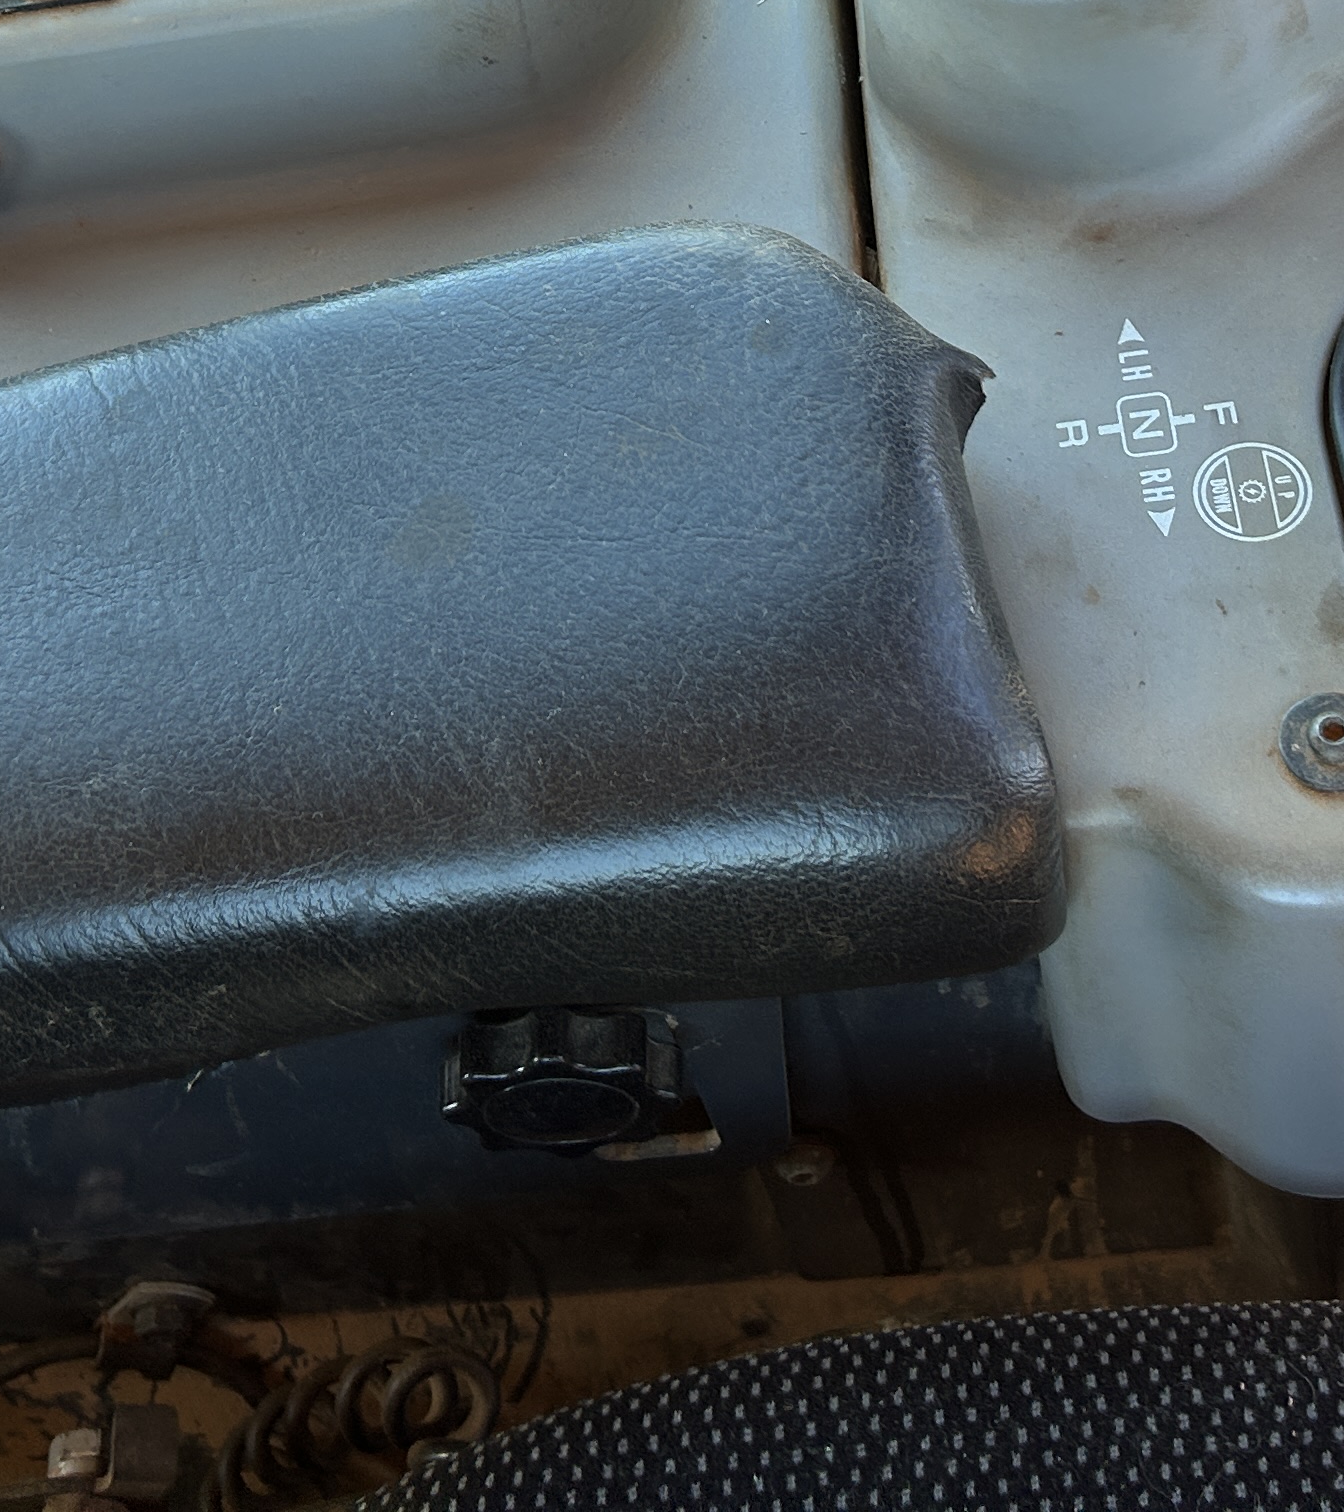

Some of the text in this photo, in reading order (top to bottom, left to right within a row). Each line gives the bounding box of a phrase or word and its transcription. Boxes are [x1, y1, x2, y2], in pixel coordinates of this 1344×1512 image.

[1118, 349, 1154, 381] LH
[1129, 409, 1164, 440] N
[1203, 401, 1238, 425] F
[1056, 420, 1089, 448] R
[1139, 468, 1176, 502] RH
[1209, 478, 1233, 513] DOWN
[1274, 474, 1296, 499] UP
